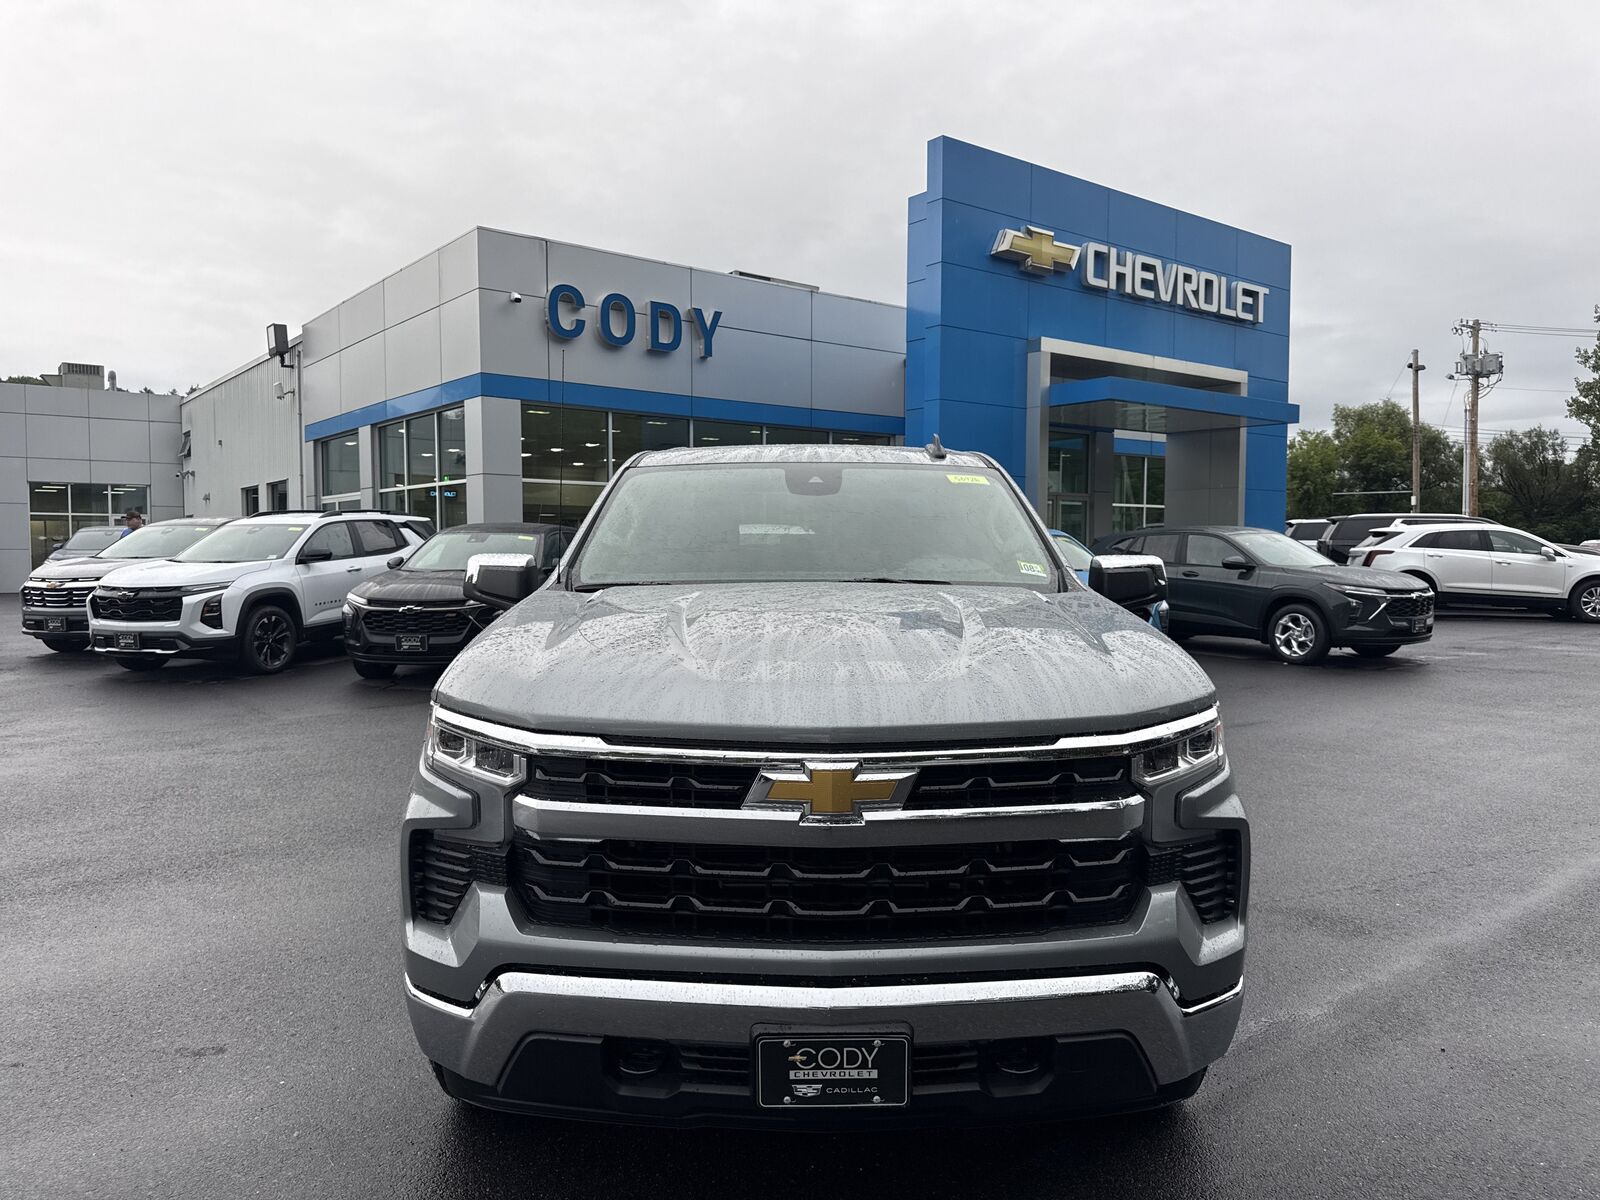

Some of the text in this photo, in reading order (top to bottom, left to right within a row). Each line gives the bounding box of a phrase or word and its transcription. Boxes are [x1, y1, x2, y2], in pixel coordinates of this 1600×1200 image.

[1082, 241, 1270, 323] CHEVROLET
[545, 284, 722, 358] CODY
[793, 1070, 873, 1078] CHEVROLET
[794, 1047, 879, 1069] CODY
